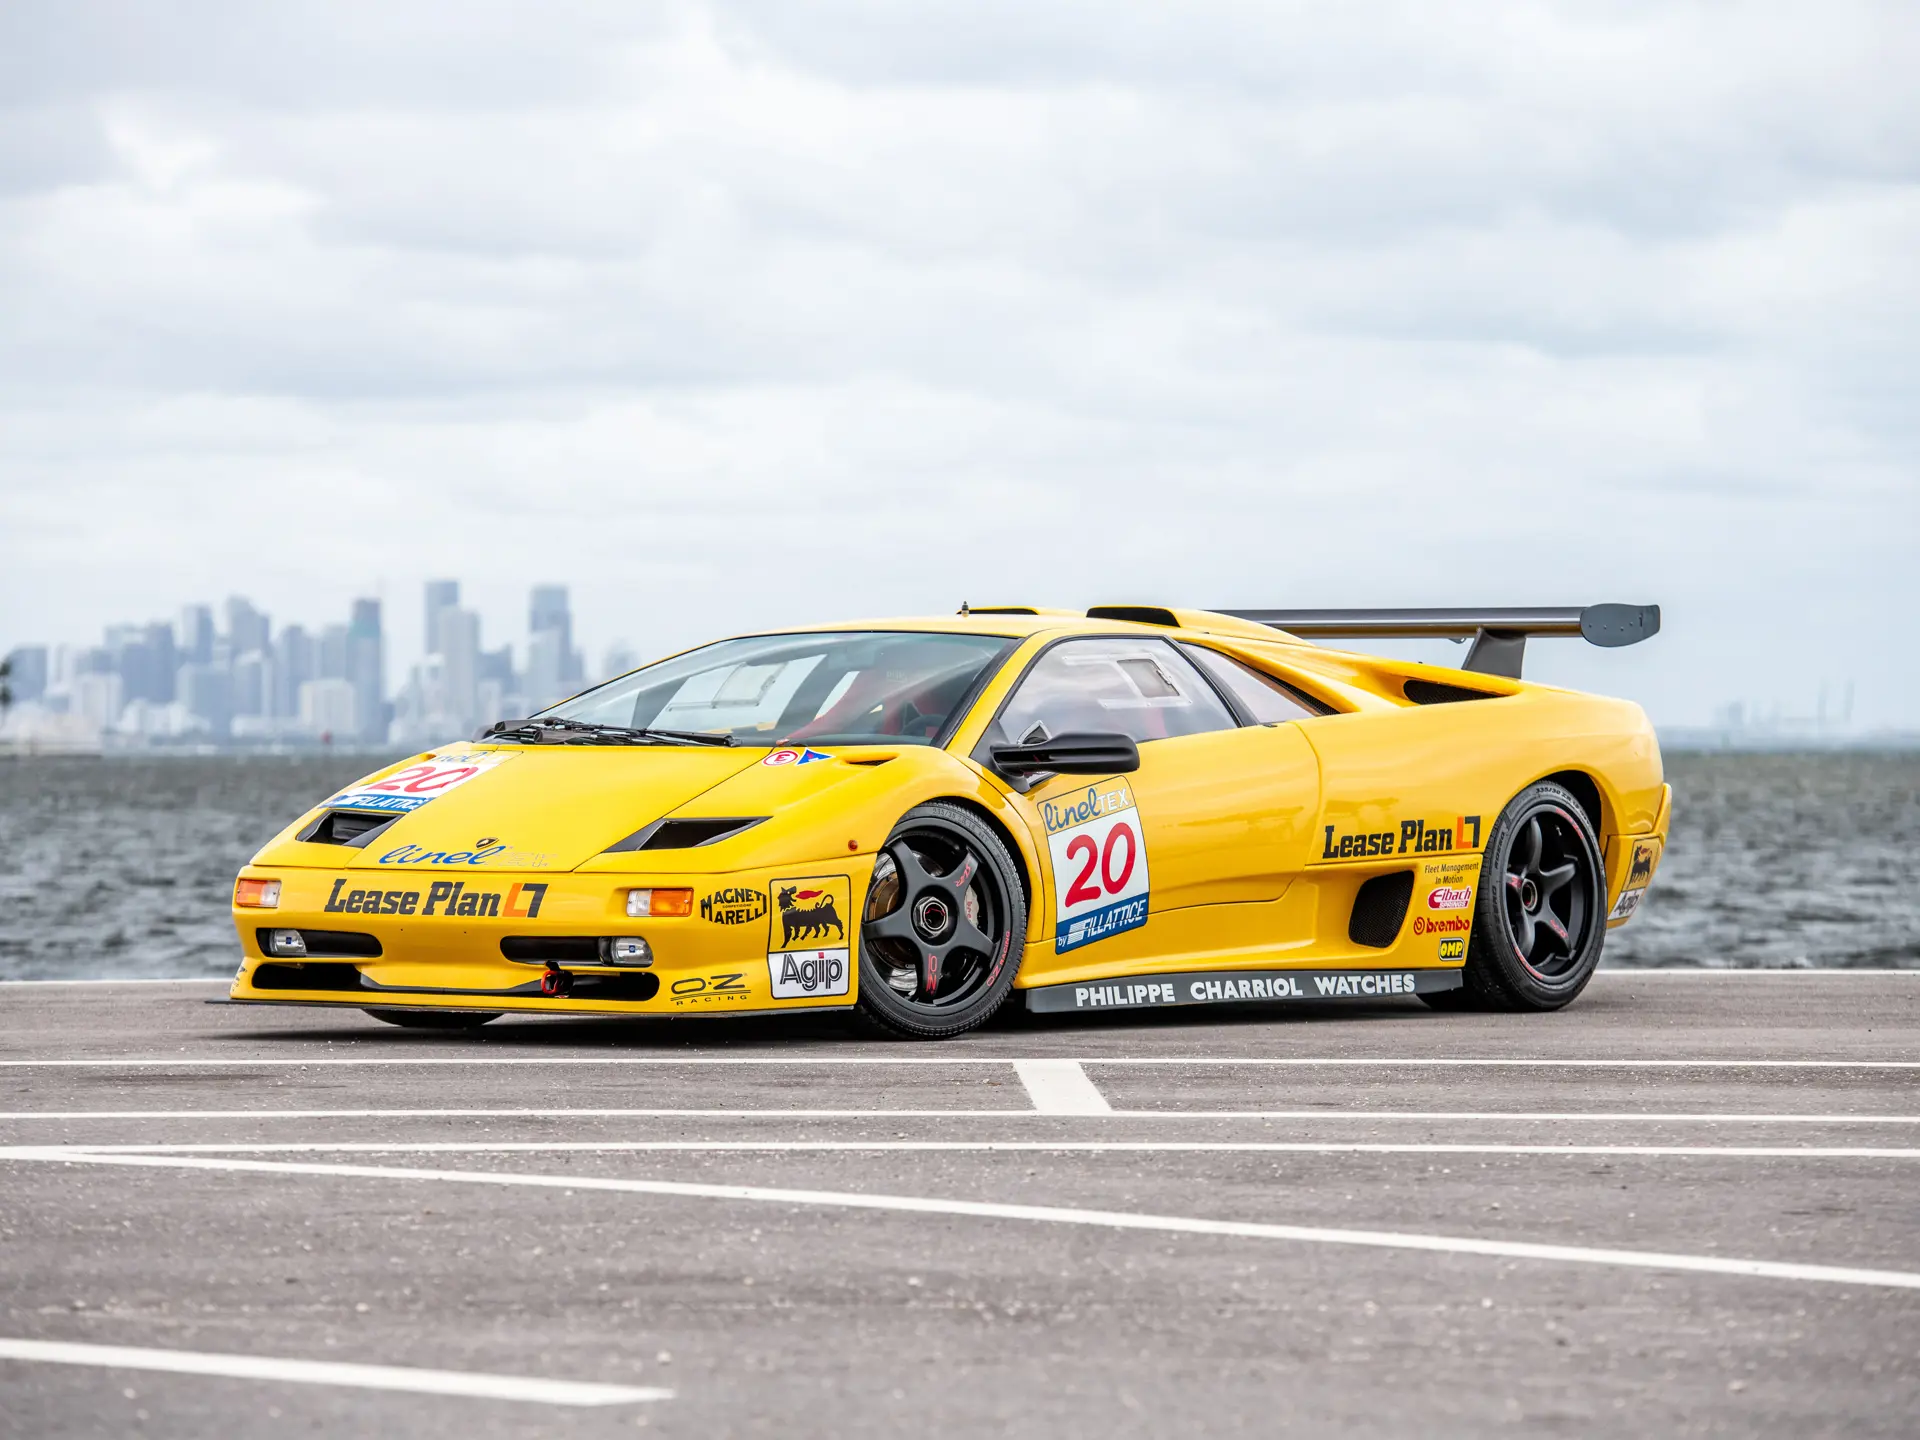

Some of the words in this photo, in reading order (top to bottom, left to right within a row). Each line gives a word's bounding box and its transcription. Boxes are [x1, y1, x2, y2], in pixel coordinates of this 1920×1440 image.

[364, 766, 479, 793] 20
[1323, 825, 1394, 859] Lease
[1398, 820, 1452, 853] Plan
[1065, 822, 1136, 907] 20
[1425, 864, 1439, 874] Fleet
[1441, 862, 1479, 873] Management
[1443, 874, 1463, 884] Motion
[324, 878, 420, 915] Lease
[422, 881, 501, 917] Plan
[700, 888, 767, 908] MAGNETI
[1428, 887, 1471, 908] Eibach
[700, 905, 767, 925] MARELLI
[1058, 936, 1067, 947] by
[1082, 899, 1147, 938] FILLATTICE
[1426, 915, 1470, 933] brembo
[1000, 931, 1011, 965] RACING
[1441, 942, 1463, 957] OMP
[780, 953, 842, 990] Agip
[676, 995, 747, 1006] RACING
[1075, 983, 1175, 1007] PHILIPPE
[1190, 977, 1303, 1001] CHARRIOL
[1313, 974, 1415, 995] WATCHES
